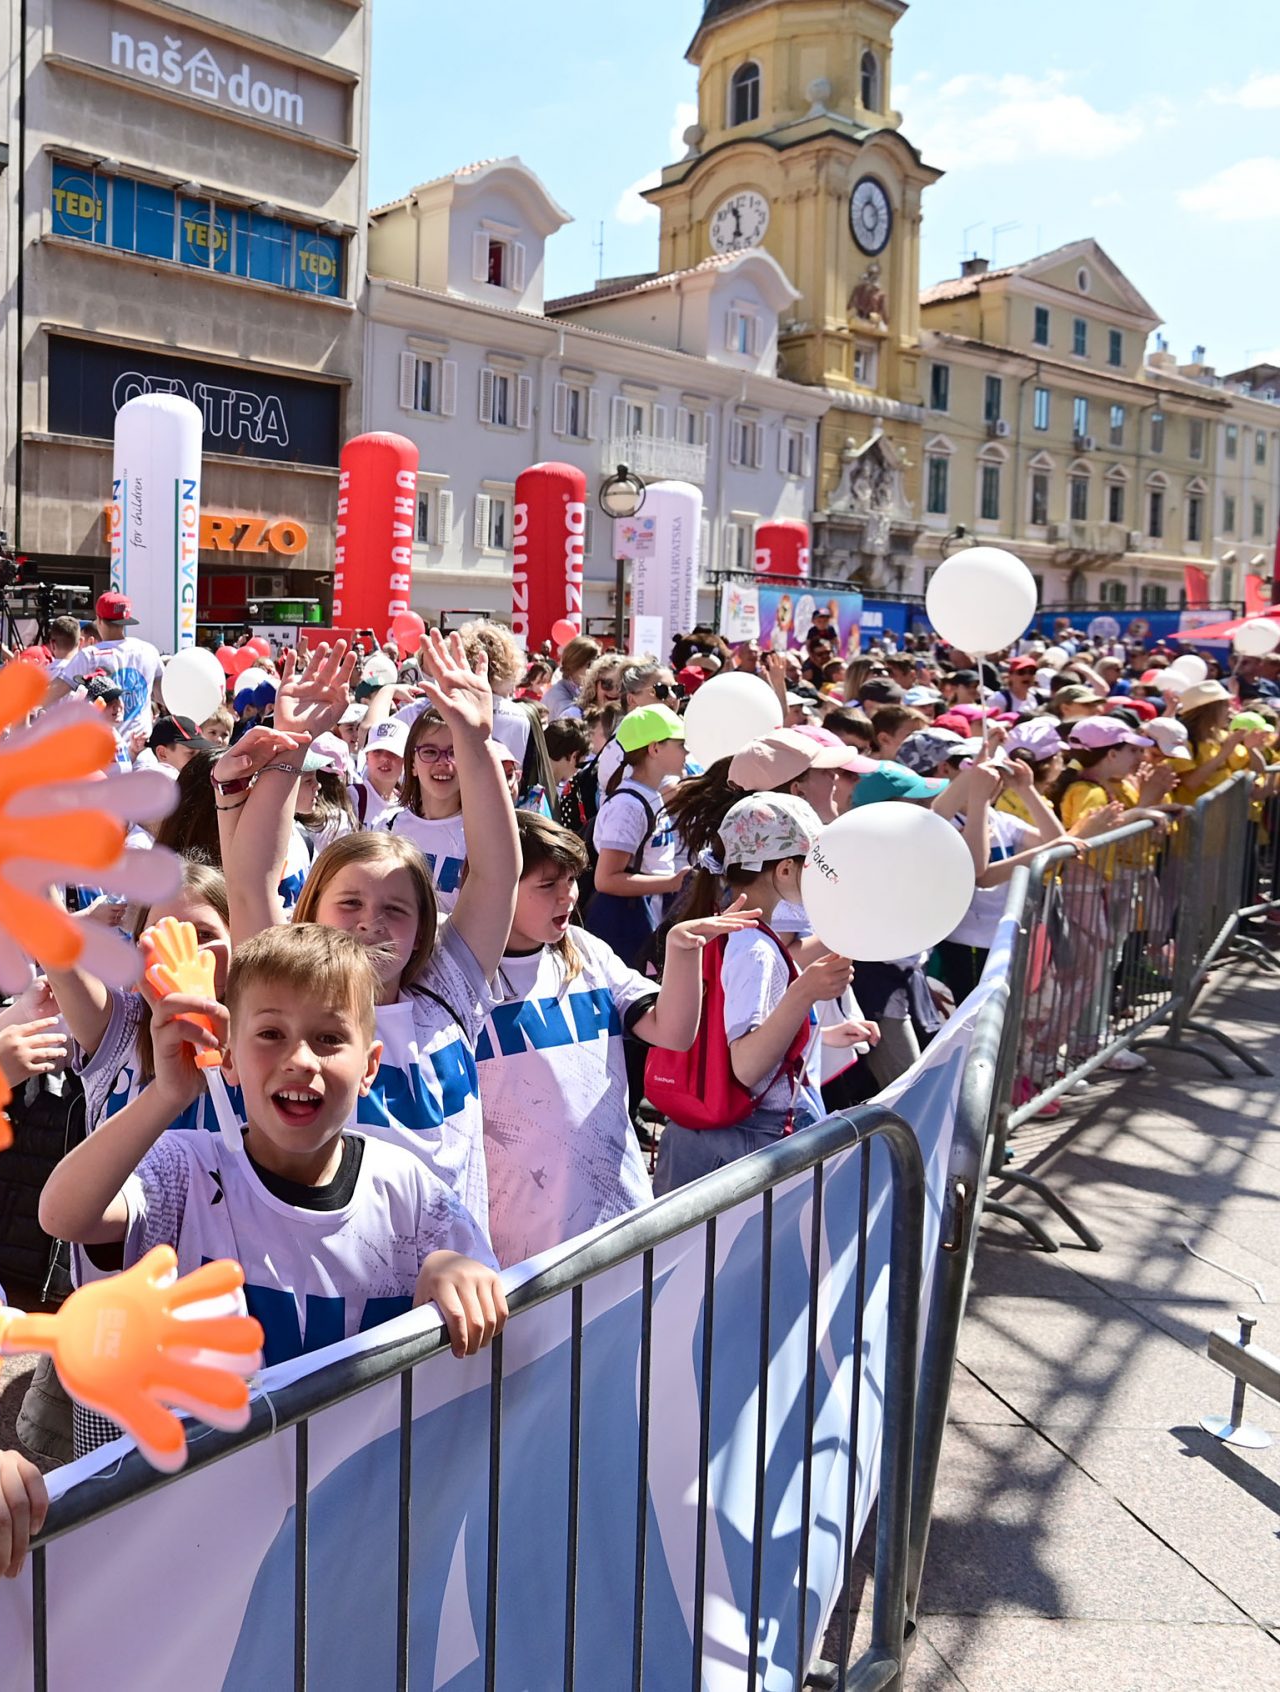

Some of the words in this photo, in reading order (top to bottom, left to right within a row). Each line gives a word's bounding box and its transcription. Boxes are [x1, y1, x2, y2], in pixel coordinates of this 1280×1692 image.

[111, 30, 185, 87] naš
[227, 65, 304, 125] dom
[52, 188, 102, 222] TEDi
[184, 220, 228, 251] TEDi
[298, 251, 337, 278] TEDi
